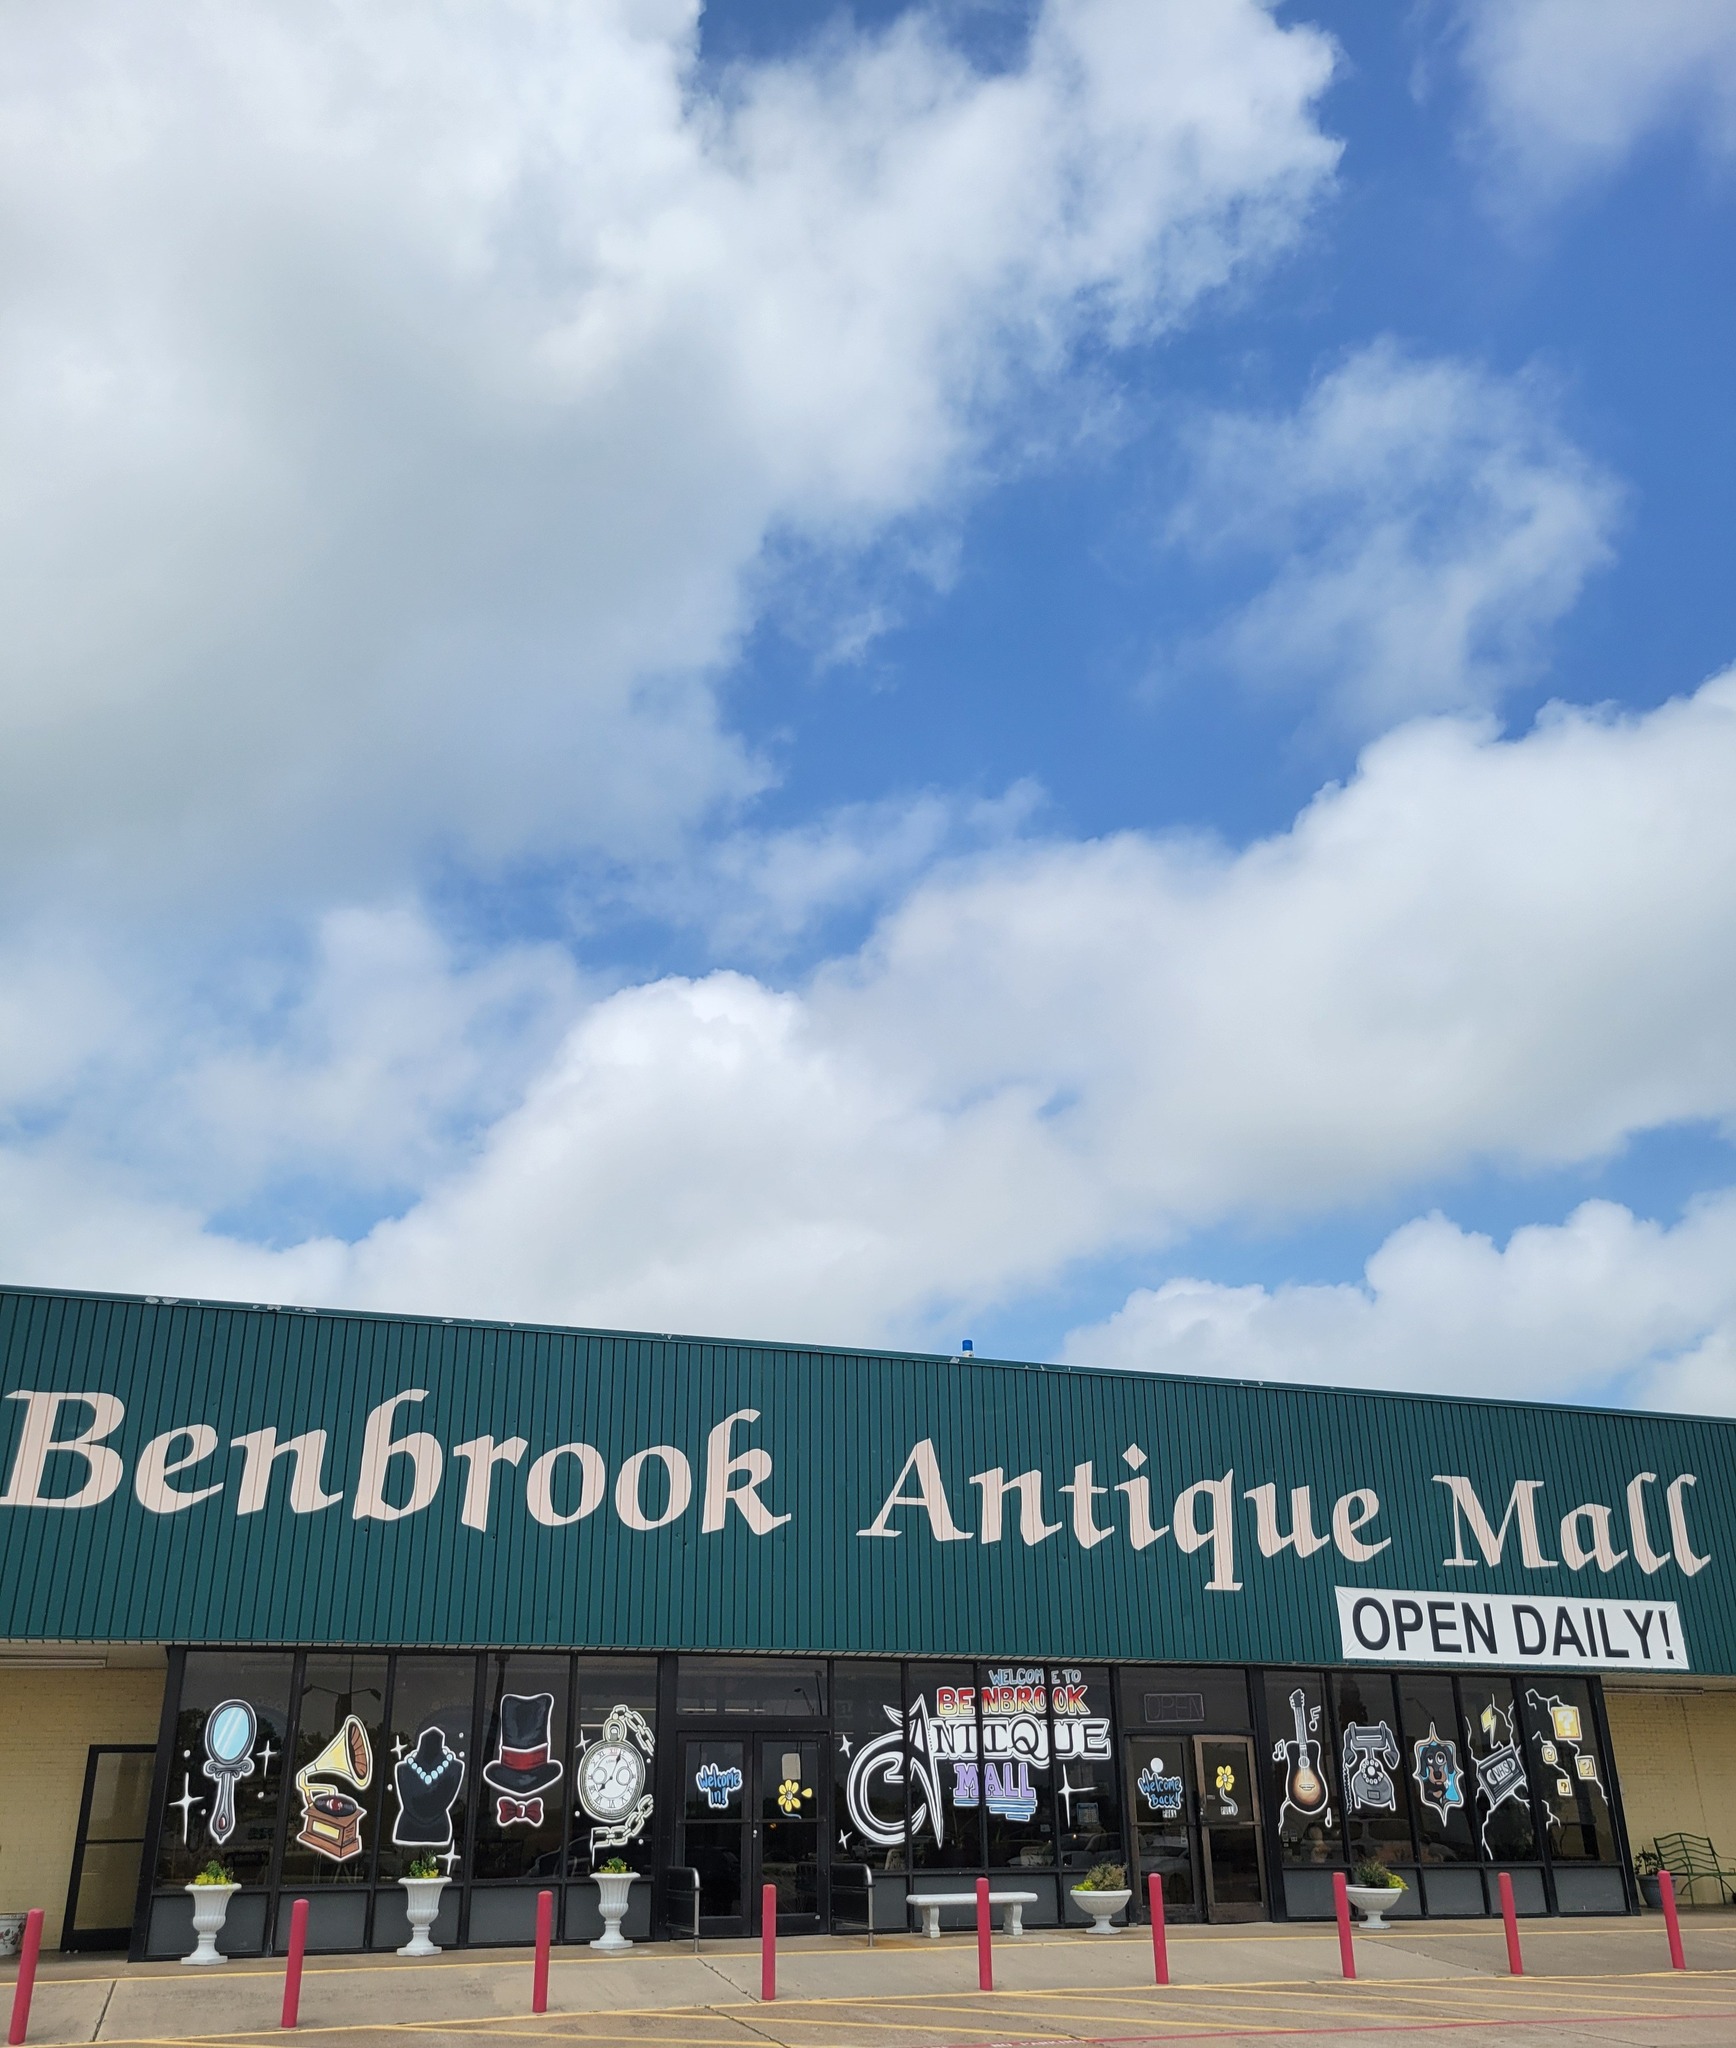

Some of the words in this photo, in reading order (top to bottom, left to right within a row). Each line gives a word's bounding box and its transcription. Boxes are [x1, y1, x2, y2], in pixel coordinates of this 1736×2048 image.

[0, 1387, 792, 1536] Benbrook
[856, 1437, 1392, 1592] Antique
[1431, 1472, 1712, 1577] Mall
[1352, 1597, 1498, 1655] OPEN
[1511, 1604, 1676, 1660] DAILY!
[988, 1667, 1060, 1686] WELCOME
[1062, 1668, 1082, 1683] TO
[936, 1685, 1091, 1715] BENBROOK
[1146, 1695, 1202, 1719] OPEN
[952, 1762, 1036, 1799] MALL
[1493, 1762, 1511, 1778] VHS
